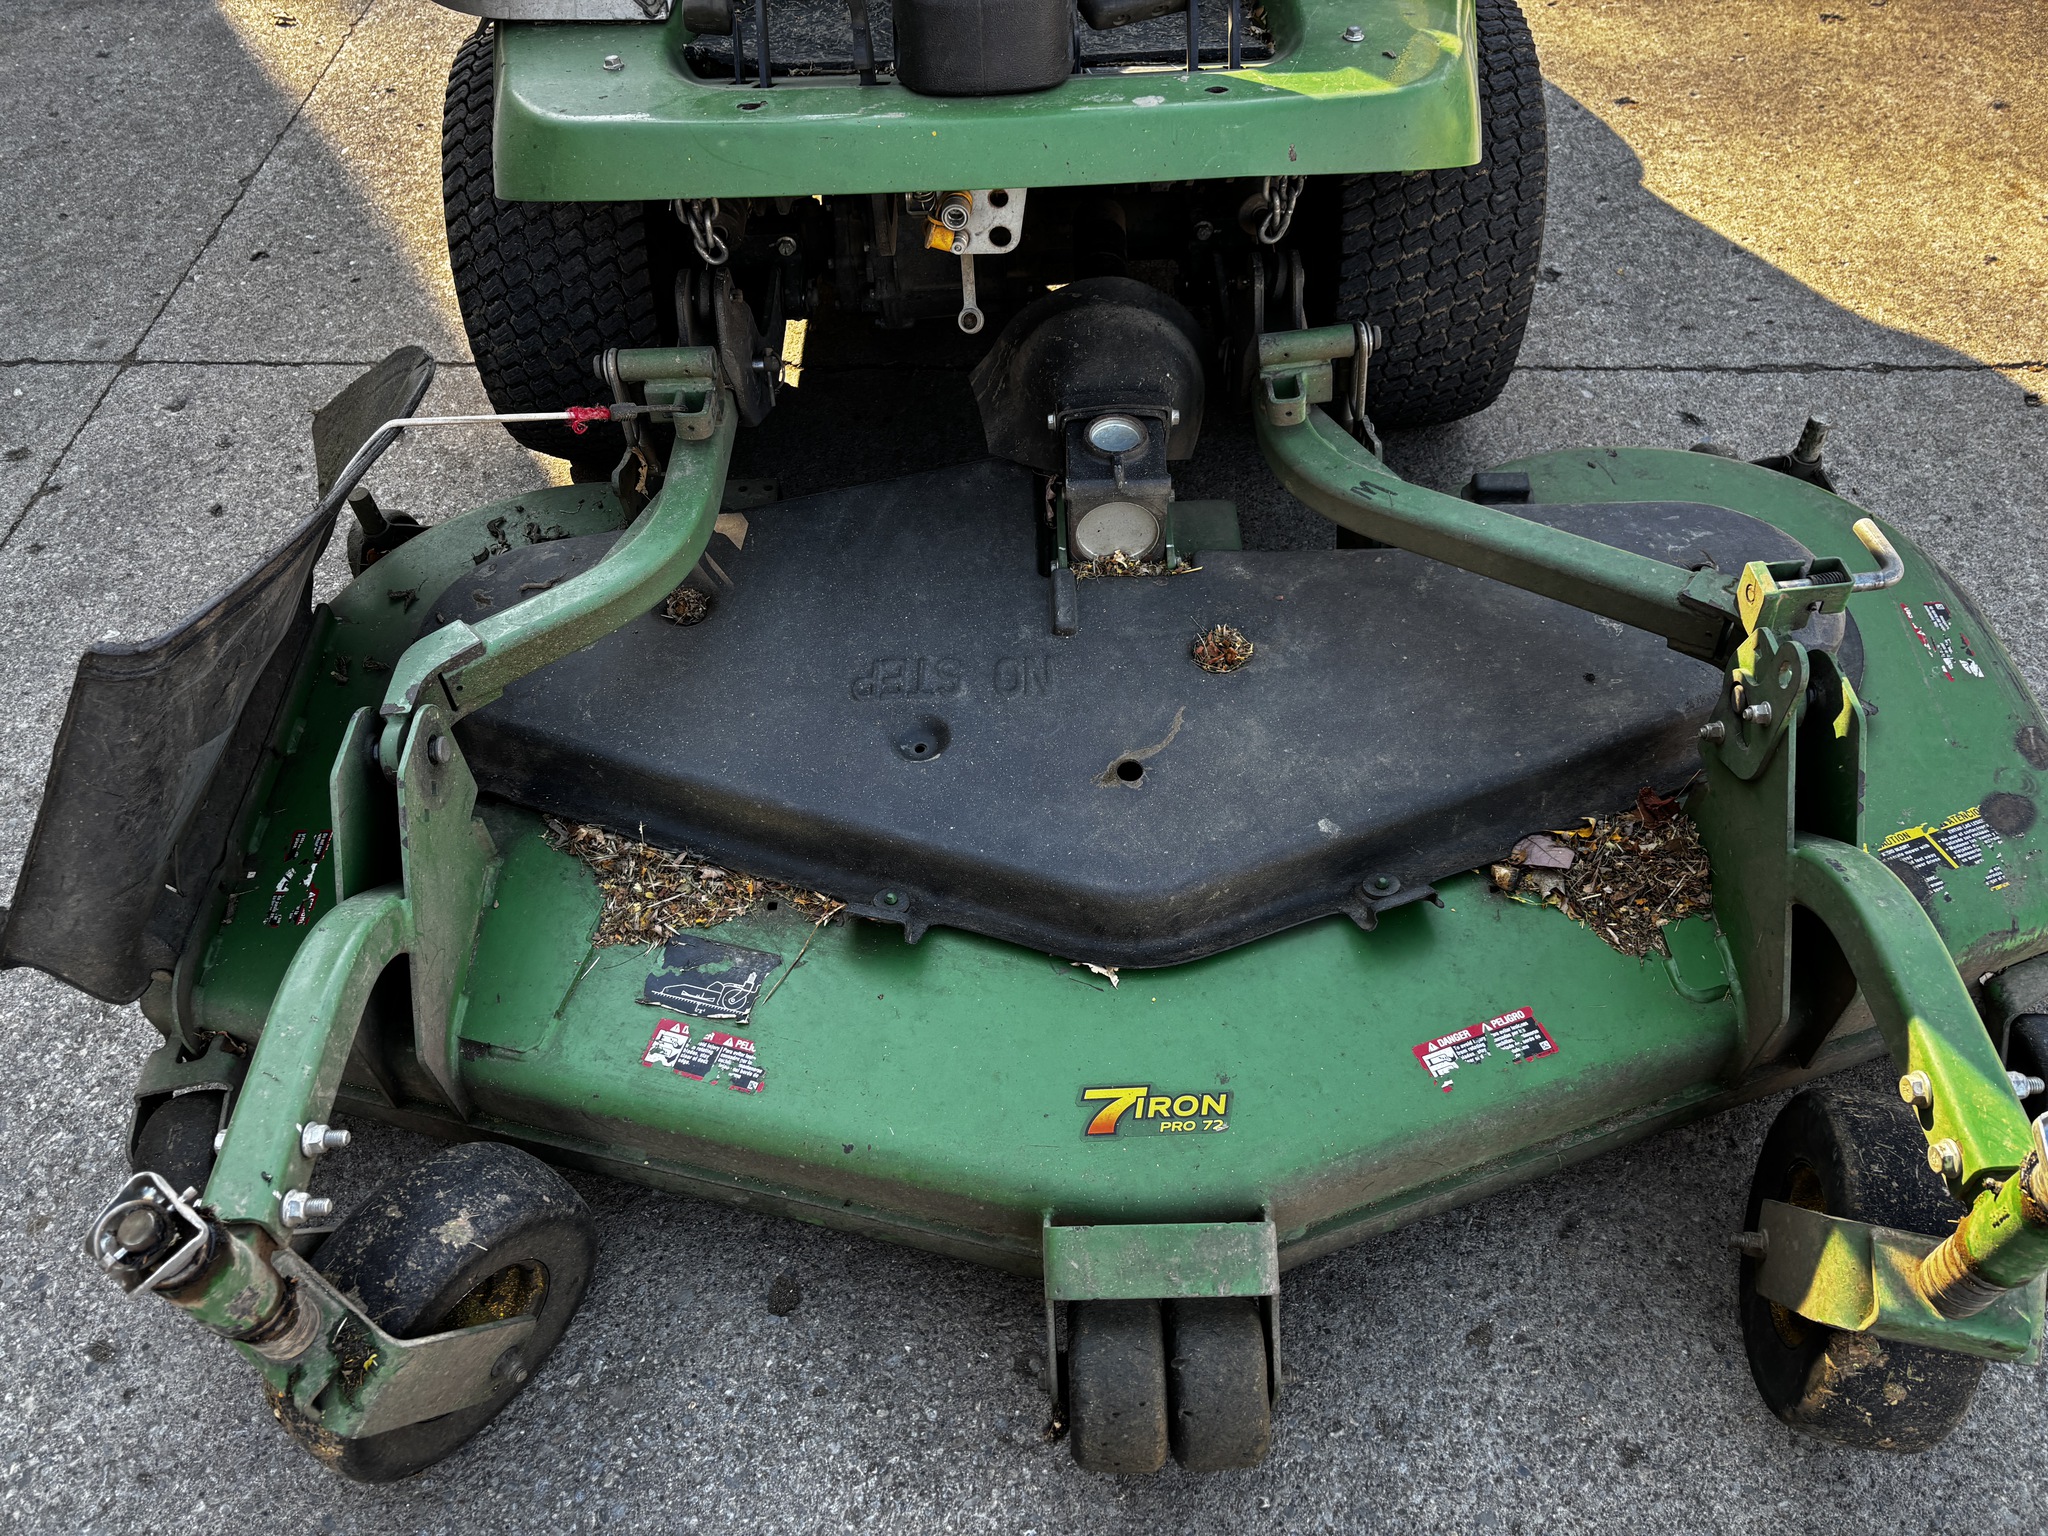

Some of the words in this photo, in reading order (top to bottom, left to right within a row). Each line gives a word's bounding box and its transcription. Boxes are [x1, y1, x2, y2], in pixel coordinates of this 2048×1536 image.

[852, 657, 962, 701] STEP
[994, 656, 1053, 696] NO
[1490, 1010, 1525, 1029] PELIGRO
[1437, 1029, 1472, 1048] DANGER
[1159, 1120, 1197, 1133] PRO
[1202, 1119, 1226, 1132] 72
